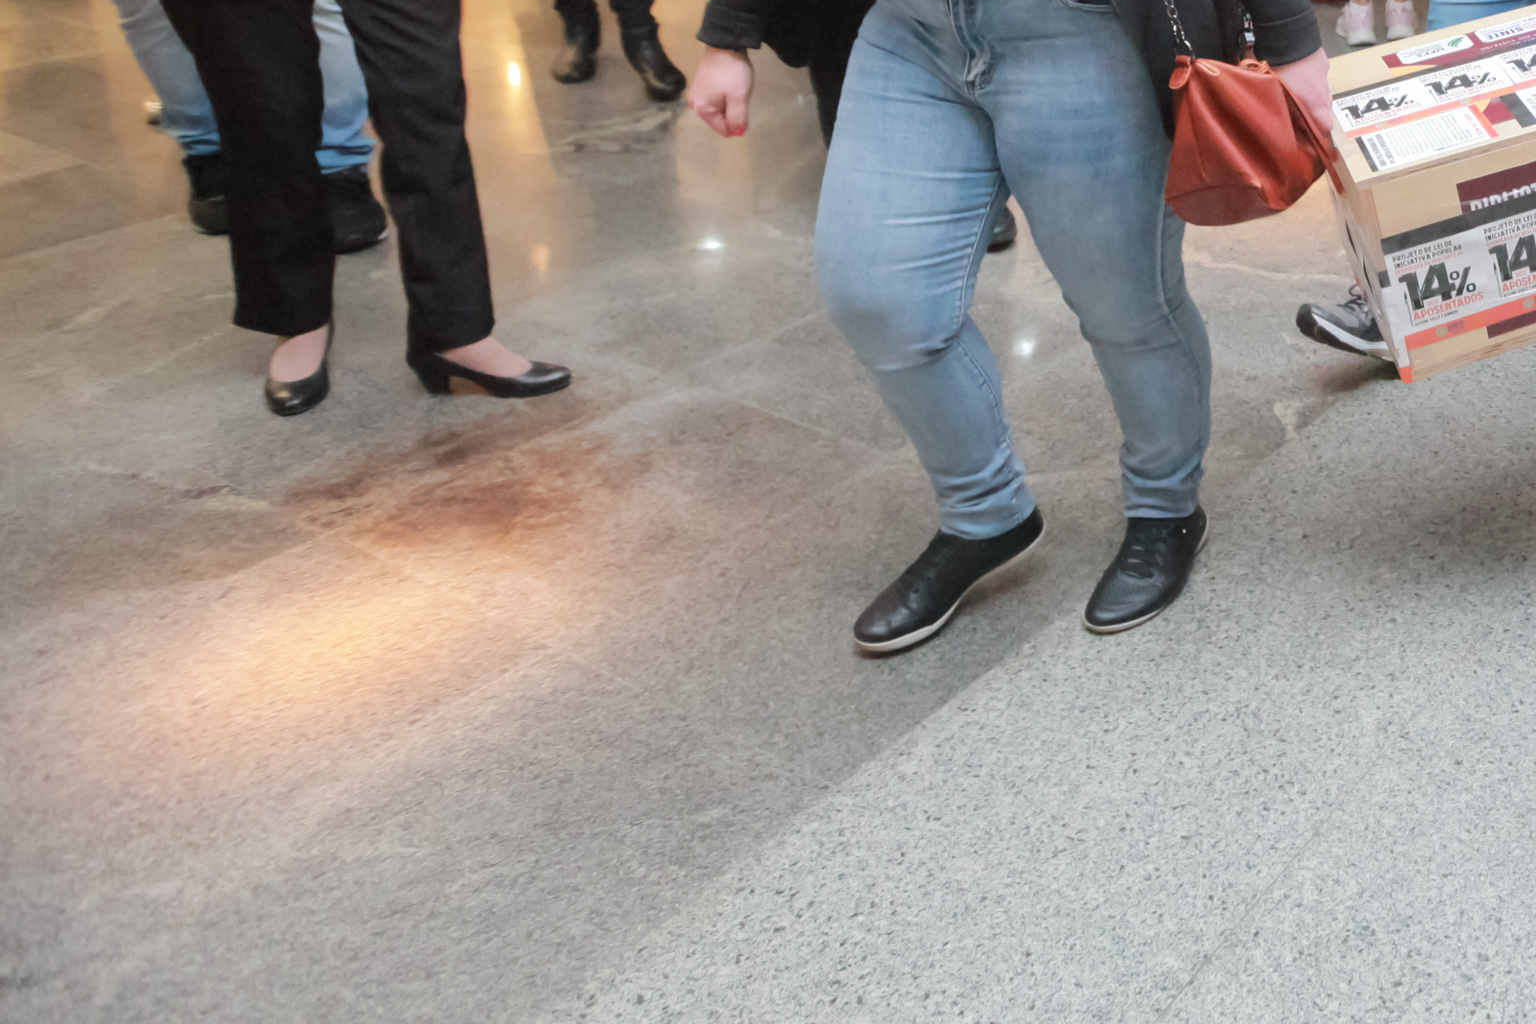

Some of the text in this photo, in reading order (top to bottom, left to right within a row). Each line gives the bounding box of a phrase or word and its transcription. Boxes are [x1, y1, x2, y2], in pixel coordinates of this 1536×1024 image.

[1483, 26, 1525, 40] SINTE
[1424, 72, 1496, 96] 14%
[1341, 94, 1414, 120] 14%
[1484, 220, 1512, 234] PROJETO
[1485, 226, 1520, 241] INICIATIVA
[1392, 248, 1422, 262] PROJETO
[1394, 244, 1462, 269] INICIATIVA POPULAR
[1398, 262, 1476, 311] 14%
[1413, 292, 1484, 321] APOSENTADOS
